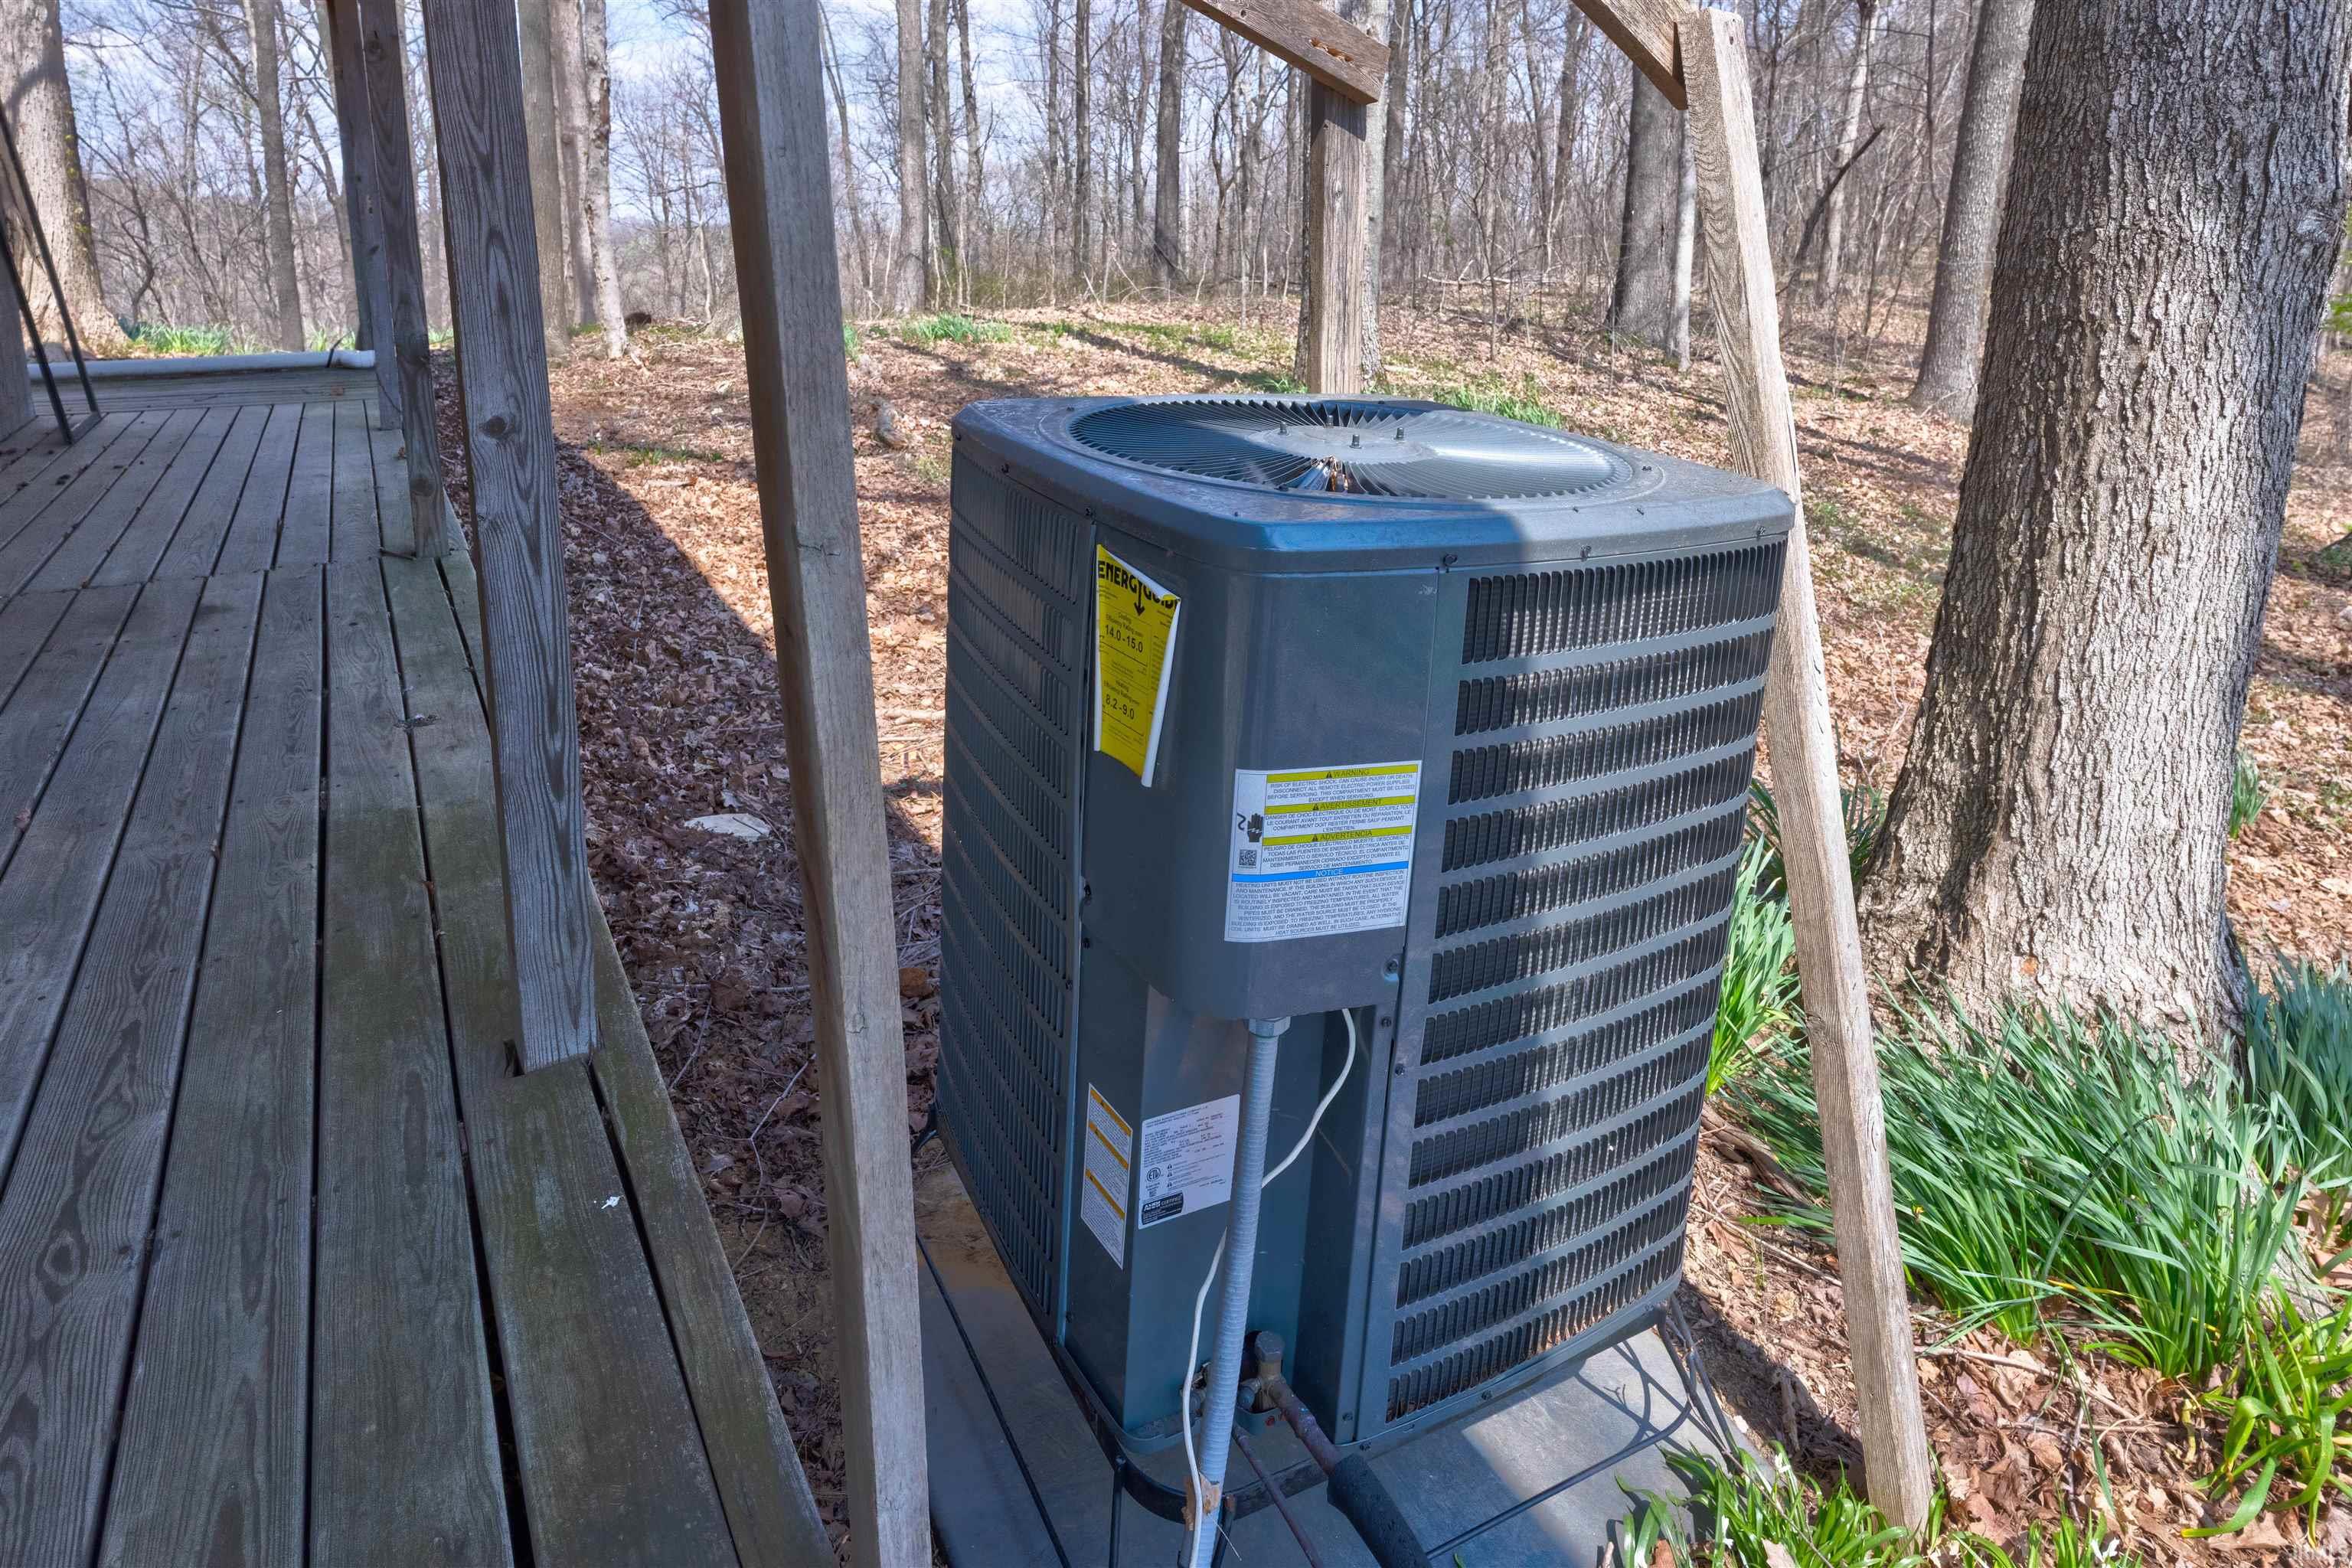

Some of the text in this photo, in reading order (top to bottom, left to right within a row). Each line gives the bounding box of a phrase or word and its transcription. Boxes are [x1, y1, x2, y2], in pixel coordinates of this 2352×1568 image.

[1334, 769, 1370, 778] WARNING
[1320, 799, 1381, 810] AVERTISSEMENT
[1321, 830, 1372, 841] ADVERTENCIA
[1315, 868, 1344, 877] NOTICE
